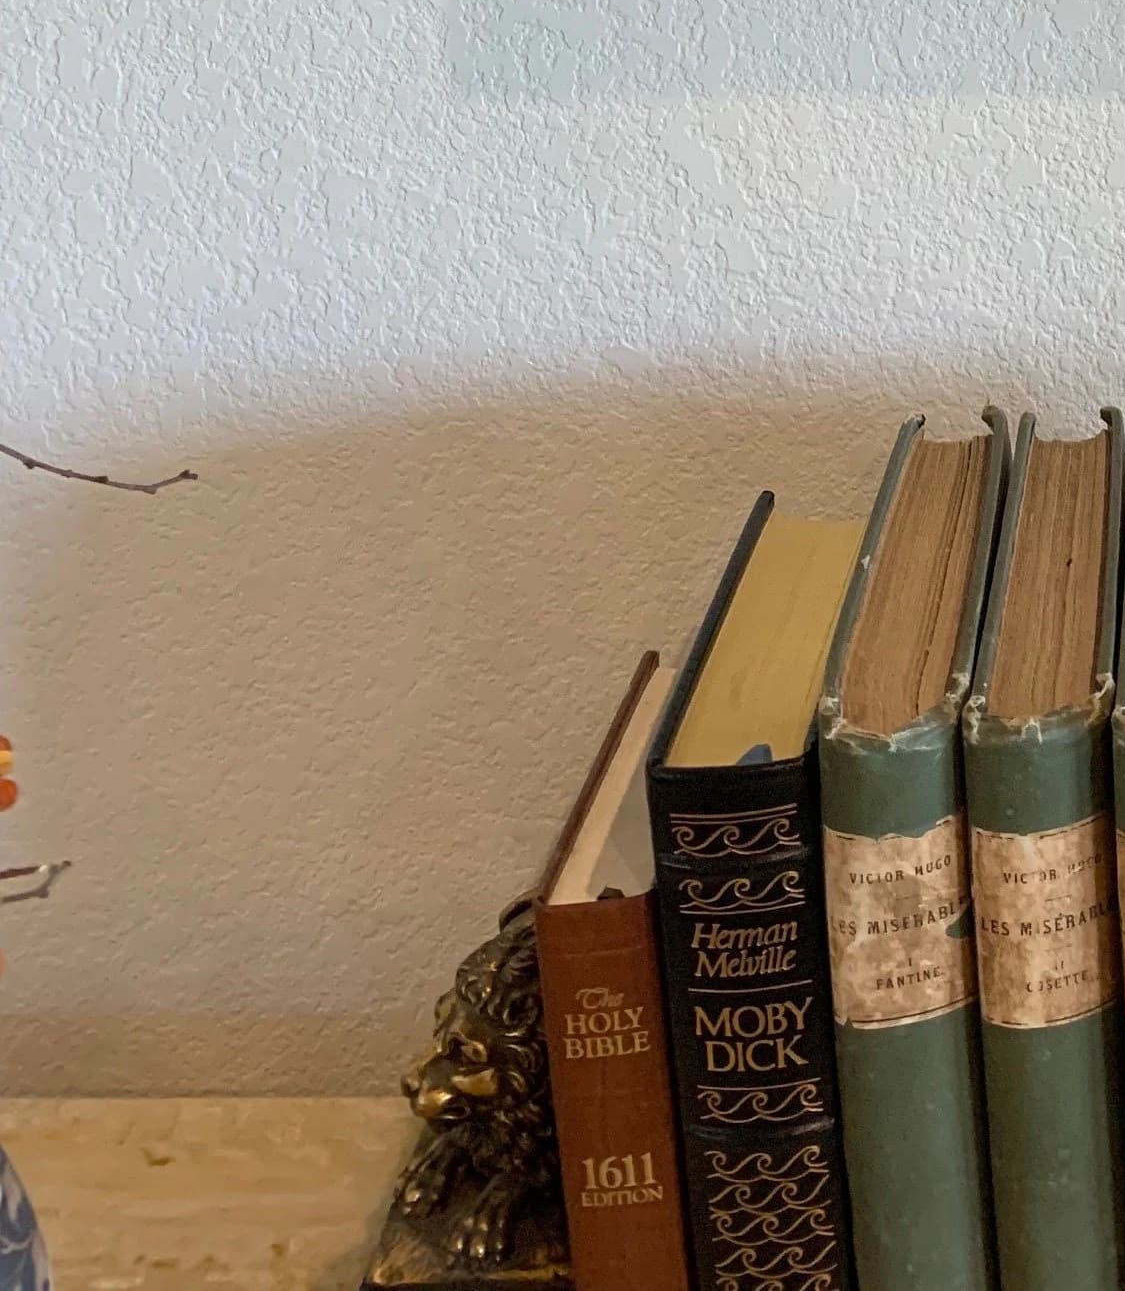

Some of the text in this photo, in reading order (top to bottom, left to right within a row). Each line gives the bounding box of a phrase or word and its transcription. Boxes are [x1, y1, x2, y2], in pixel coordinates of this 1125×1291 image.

[849, 854, 951, 885] VICTOR HUGO
[1003, 869, 1057, 885] VICOR
[690, 921, 798, 949] Herman
[981, 917, 1010, 936] LES
[694, 945, 797, 978] Melville
[564, 1006, 644, 1035] HOLY
[694, 996, 814, 1037] MOBY
[562, 1031, 651, 1059] BIBLE
[704, 1034, 809, 1072] DICK
[581, 1151, 657, 1190] 1611
[581, 1185, 664, 1207] EDITION
